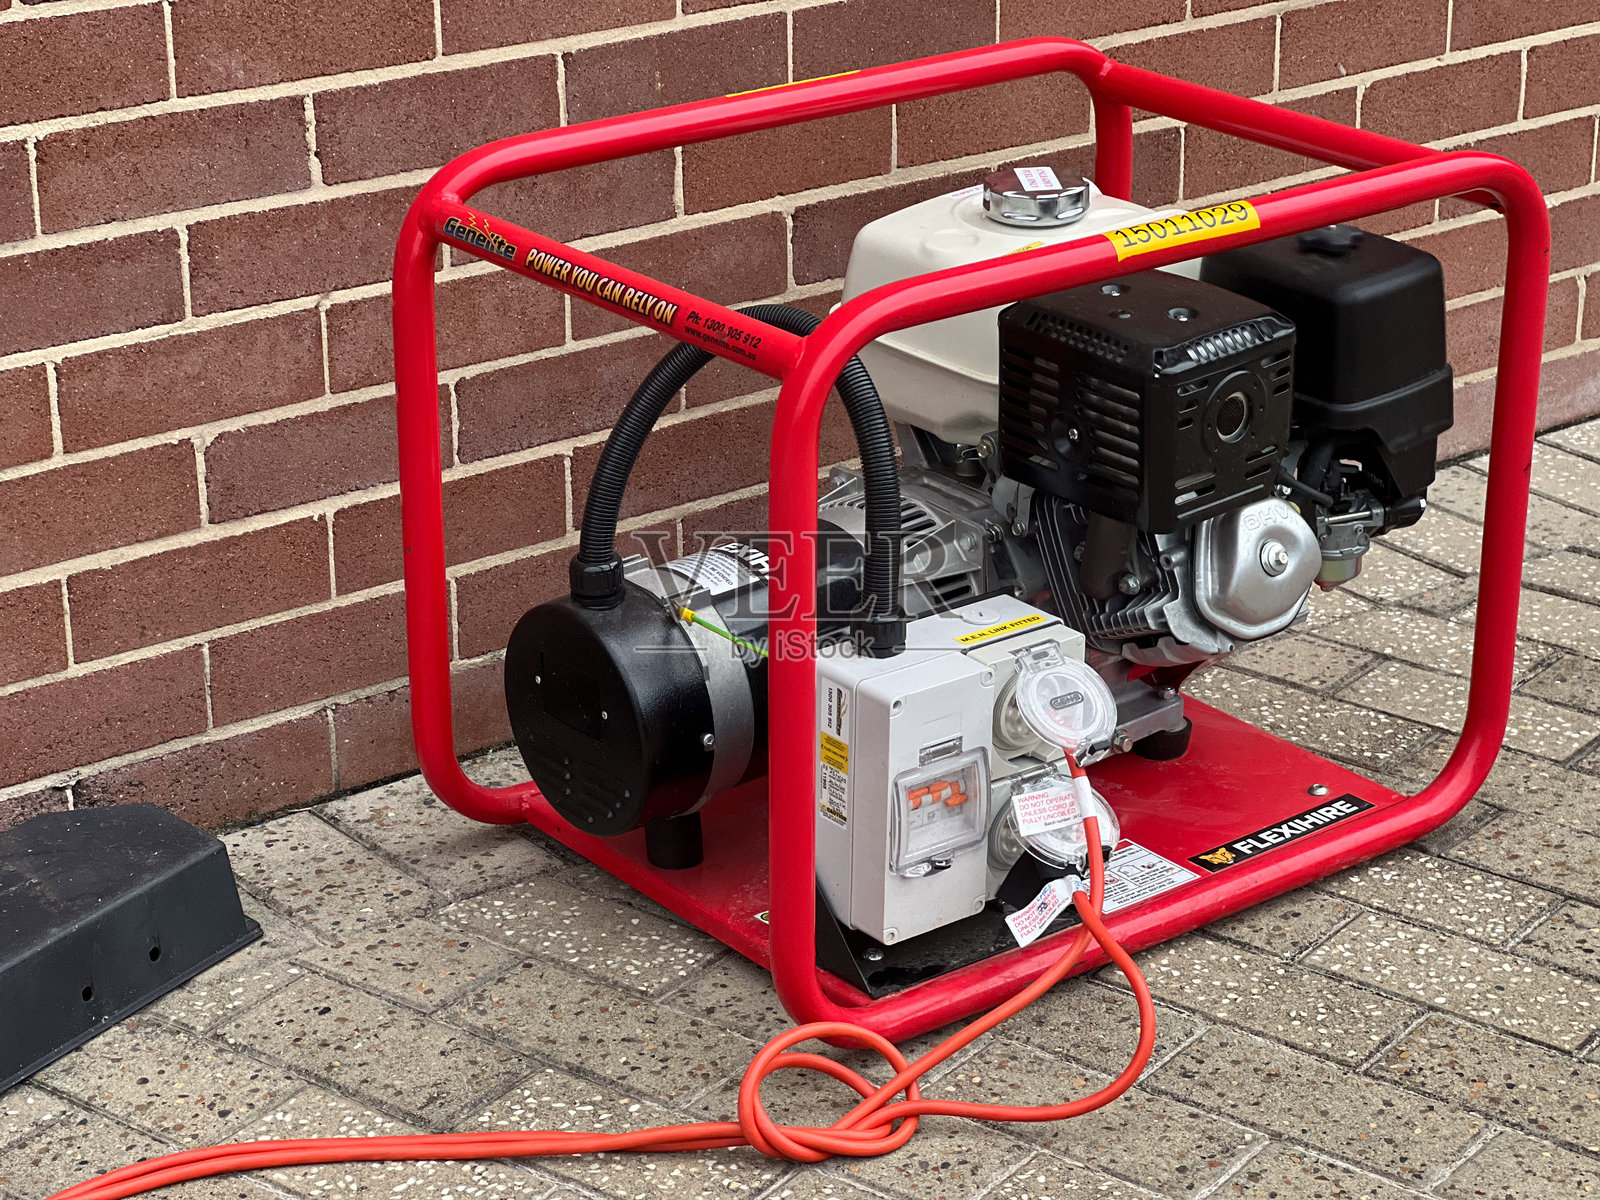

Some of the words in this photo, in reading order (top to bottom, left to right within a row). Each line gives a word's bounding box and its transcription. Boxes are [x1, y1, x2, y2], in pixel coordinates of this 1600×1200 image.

[1115, 203, 1248, 247] 15011029
[444, 216, 517, 261] Genelite
[525, 248, 572, 282] POWER
[571, 265, 599, 291] YOU
[596, 277, 626, 304] CAN
[622, 287, 658, 315] RELY
[654, 300, 678, 325] ON
[686, 311, 701, 326] Ph:
[703, 317, 725, 333] 1300
[726, 326, 743, 342] 305
[743, 334, 762, 349] 912
[1244, 503, 1289, 530] OHV
[988, 625, 1009, 634] LINK
[1009, 616, 1040, 627] FITTED
[1017, 791, 1049, 803] WARNING
[1019, 803, 1030, 811] DO
[1030, 799, 1044, 808] NOT
[1045, 792, 1076, 805] OPERATE
[1020, 808, 1047, 817] UNLESS
[1048, 802, 1067, 812] CORD
[1022, 815, 1042, 824] FULLY
[1042, 807, 1076, 821] UNCOILED
[1232, 800, 1359, 854] FLEXIHIRE
[1014, 920, 1024, 928] DO
[1024, 911, 1036, 921] NOT
[1017, 915, 1039, 934] UNLESS
[1020, 924, 1037, 938] FULLY
[1036, 899, 1060, 925] UNCOILED
